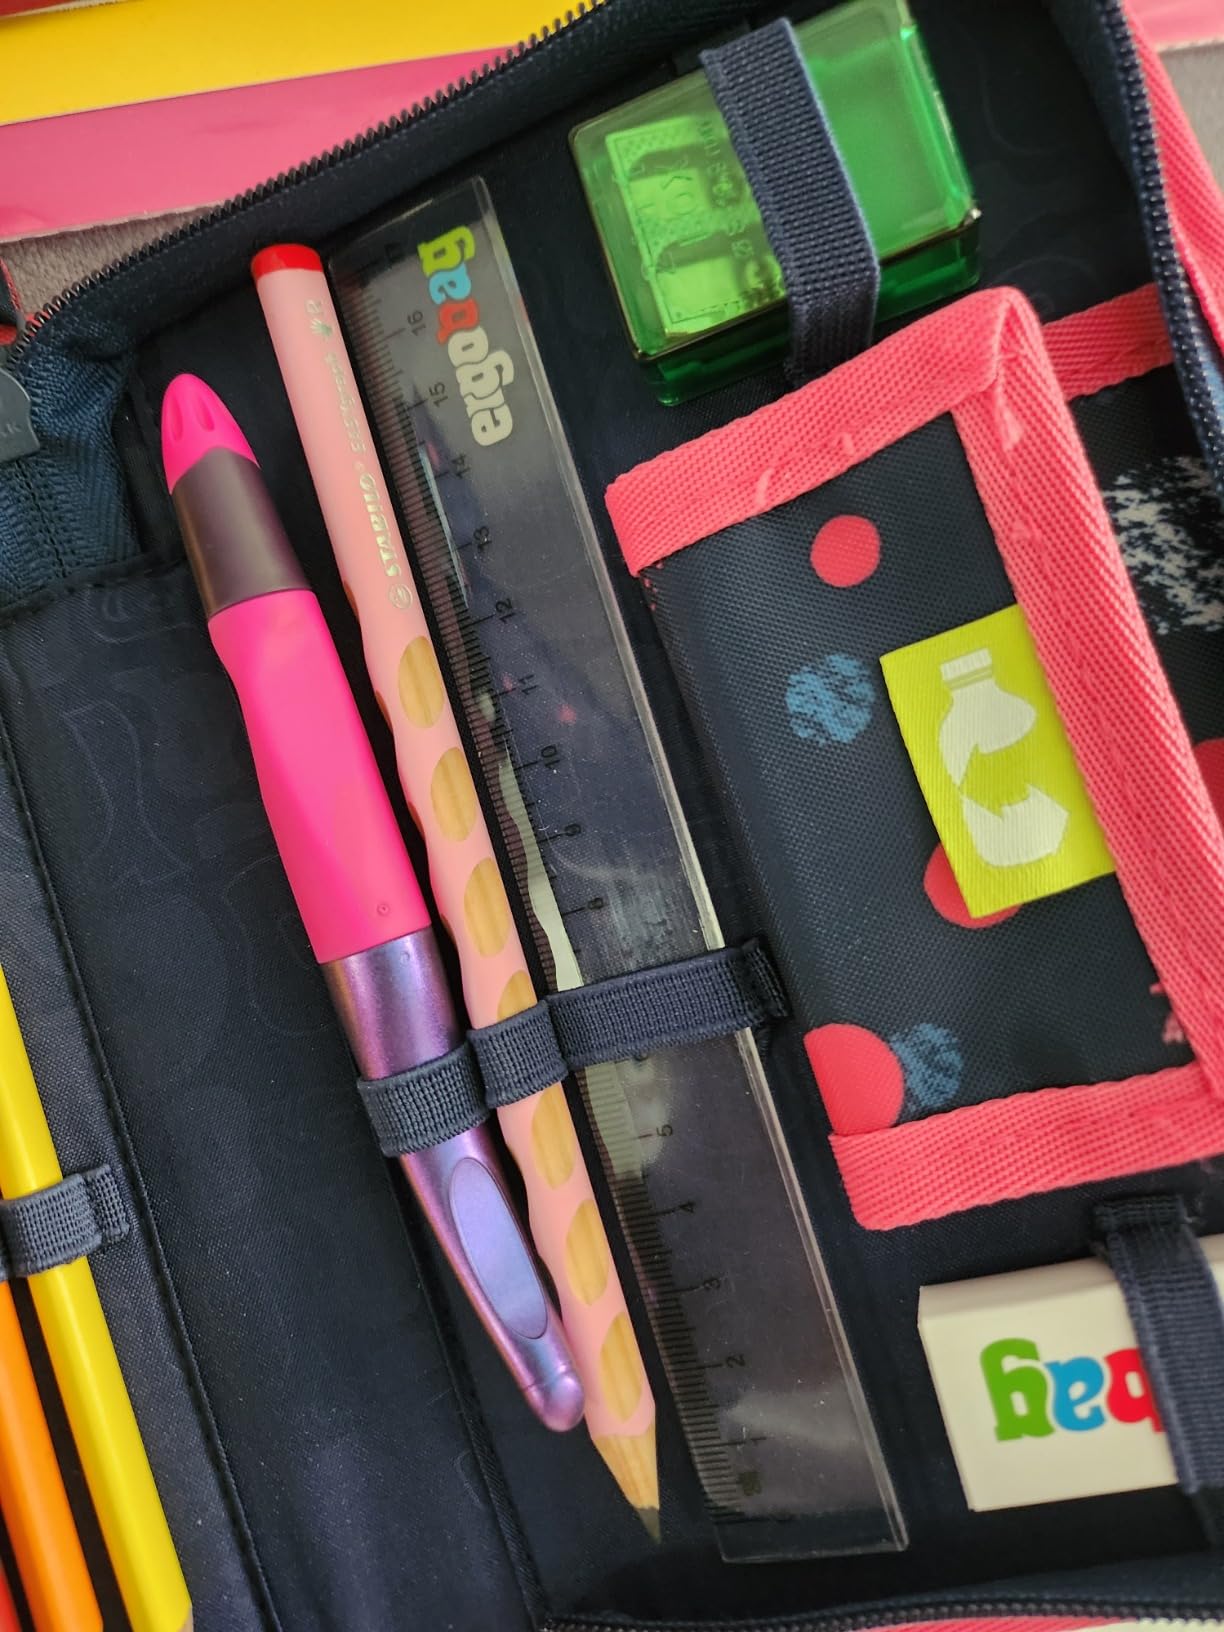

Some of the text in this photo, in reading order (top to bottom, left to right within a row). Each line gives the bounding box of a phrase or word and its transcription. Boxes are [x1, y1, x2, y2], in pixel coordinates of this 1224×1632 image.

[407, 309, 427, 337] 16
[417, 225, 515, 447] ergobag
[429, 381, 449, 409] 15
[451, 453, 472, 480] 14
[359, 473, 401, 577] STABILO
[473, 526, 493, 552] 13
[495, 598, 516, 625] 12
[517, 674, 539, 696] 11
[540, 743, 561, 769] 10
[656, 1123, 674, 1138] 5
[678, 1200, 696, 1214] 4
[725, 1353, 747, 1369] 2
